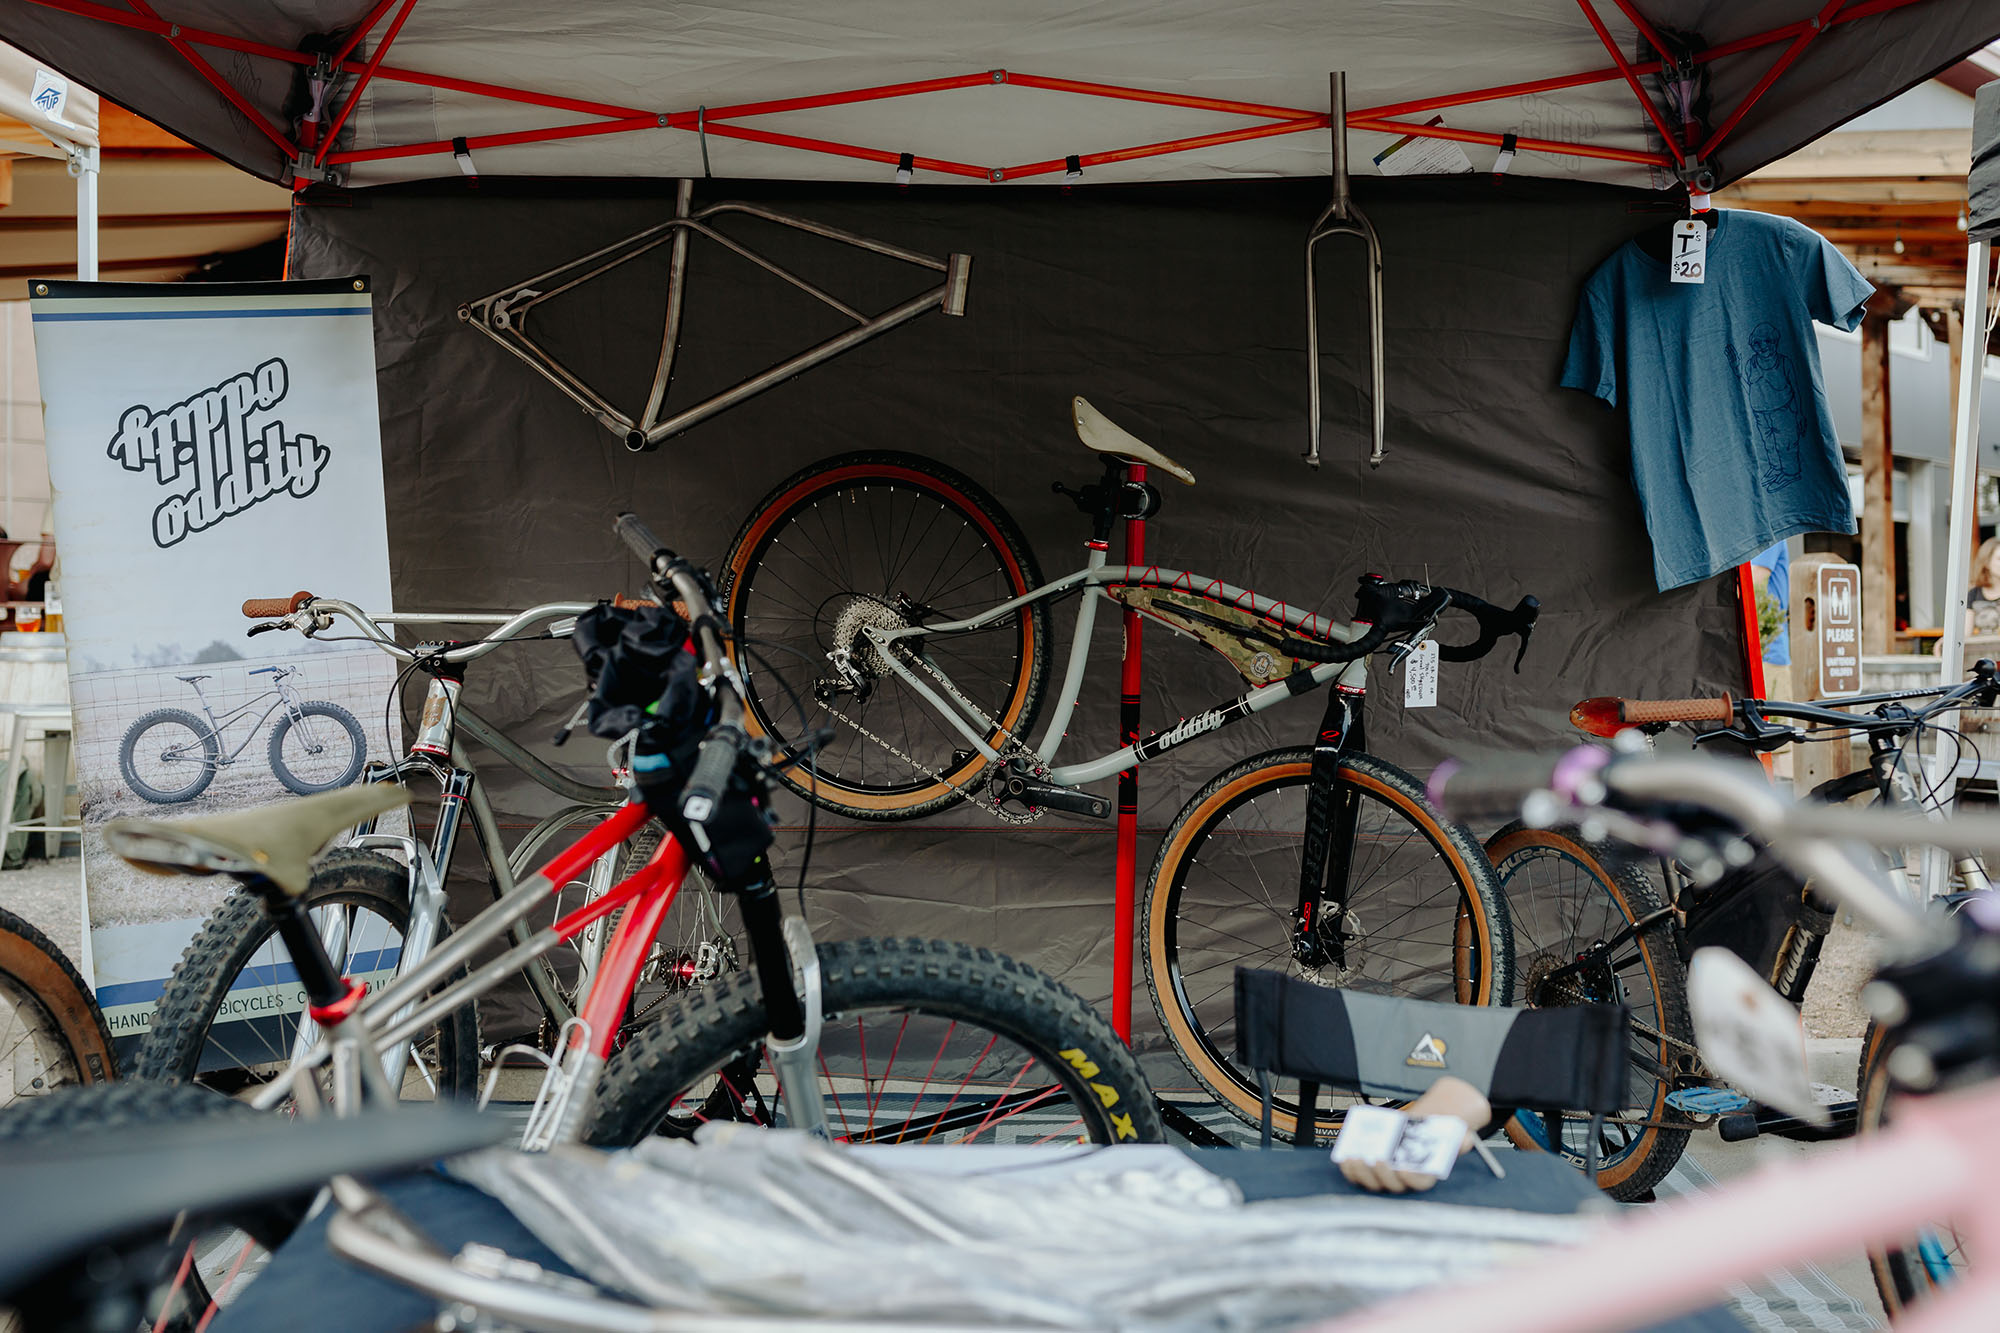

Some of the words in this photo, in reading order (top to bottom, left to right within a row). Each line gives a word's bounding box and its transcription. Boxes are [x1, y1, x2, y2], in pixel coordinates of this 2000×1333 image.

[1673, 261, 1702, 278] $20
[1826, 628, 1855, 643] PLEASE
[1159, 709, 1225, 749] oddity
[219, 994, 284, 1016] BICYCLES
